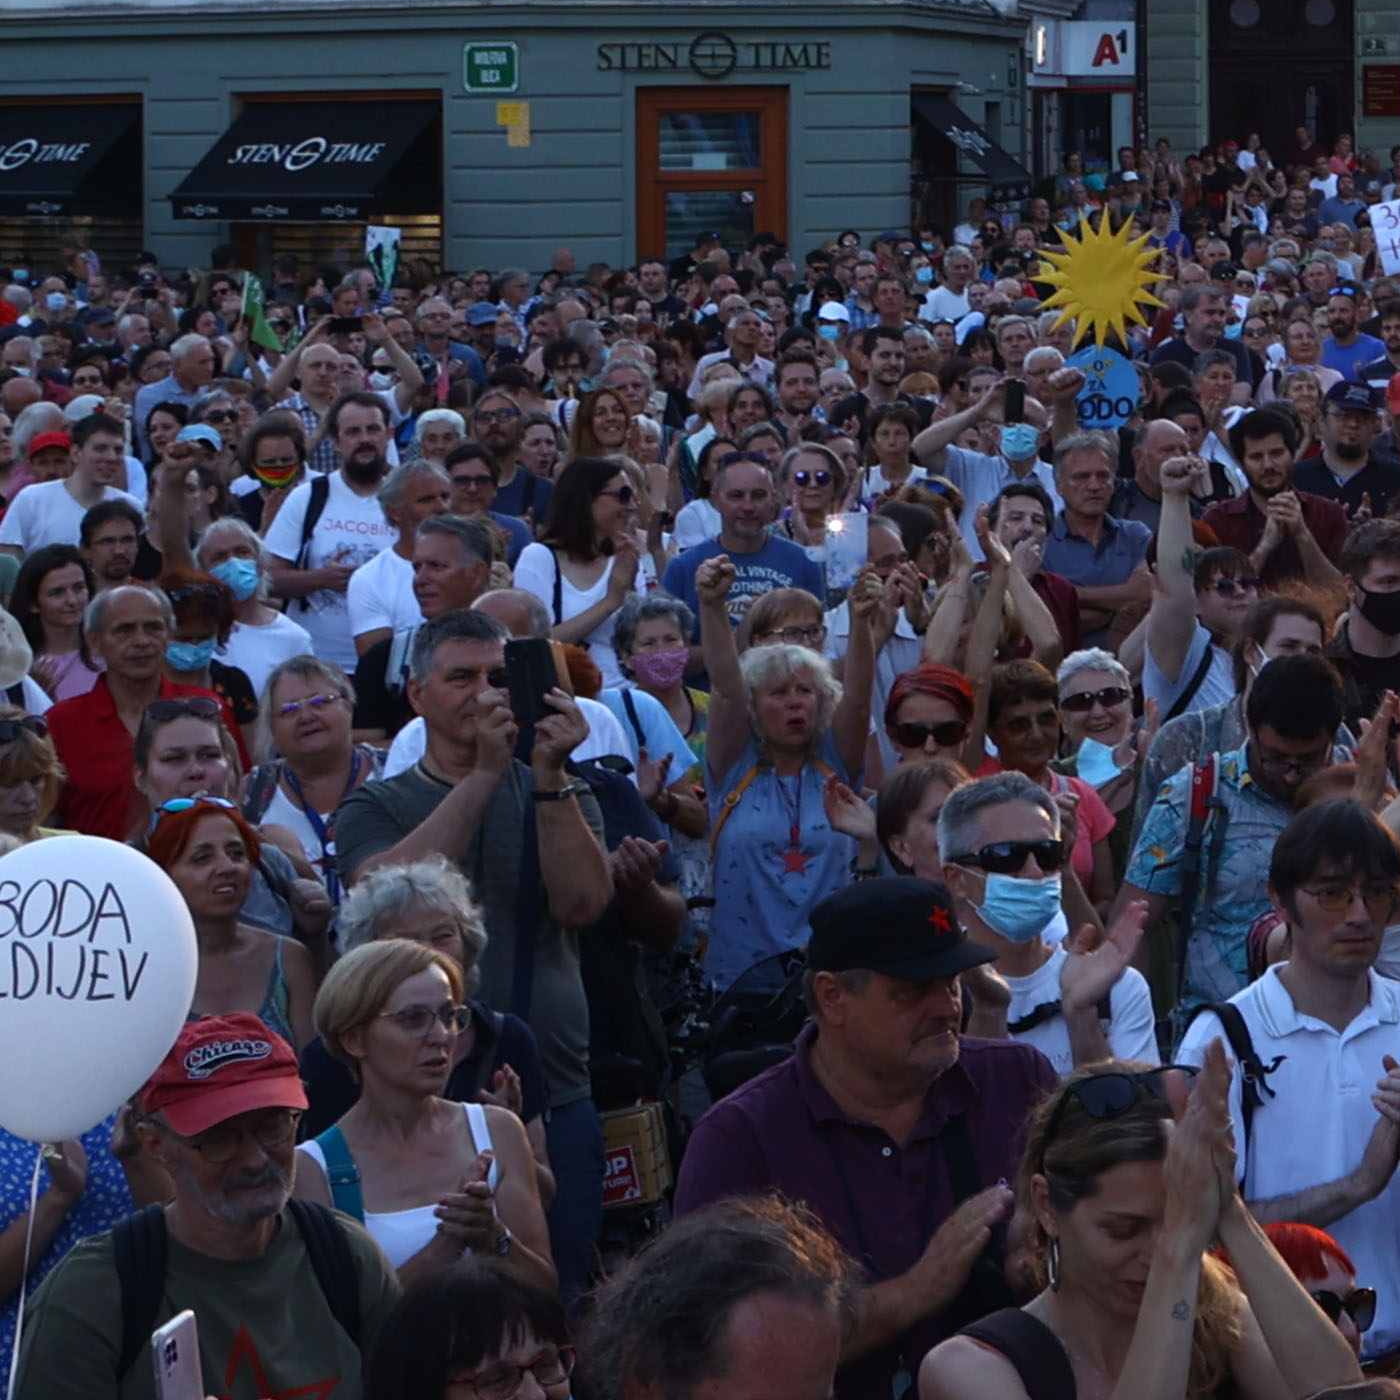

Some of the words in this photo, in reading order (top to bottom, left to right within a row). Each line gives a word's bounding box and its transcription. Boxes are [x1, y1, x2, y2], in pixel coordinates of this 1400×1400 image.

[597, 42, 679, 71] STEN
[746, 42, 832, 69] TIME
[1091, 28, 1128, 67] A1
[33, 142, 91, 162] TIME
[227, 142, 292, 164] STEN
[323, 142, 386, 162] TIME
[324, 518, 396, 537] JACOBIN
[184, 1039, 271, 1072] Chicago
